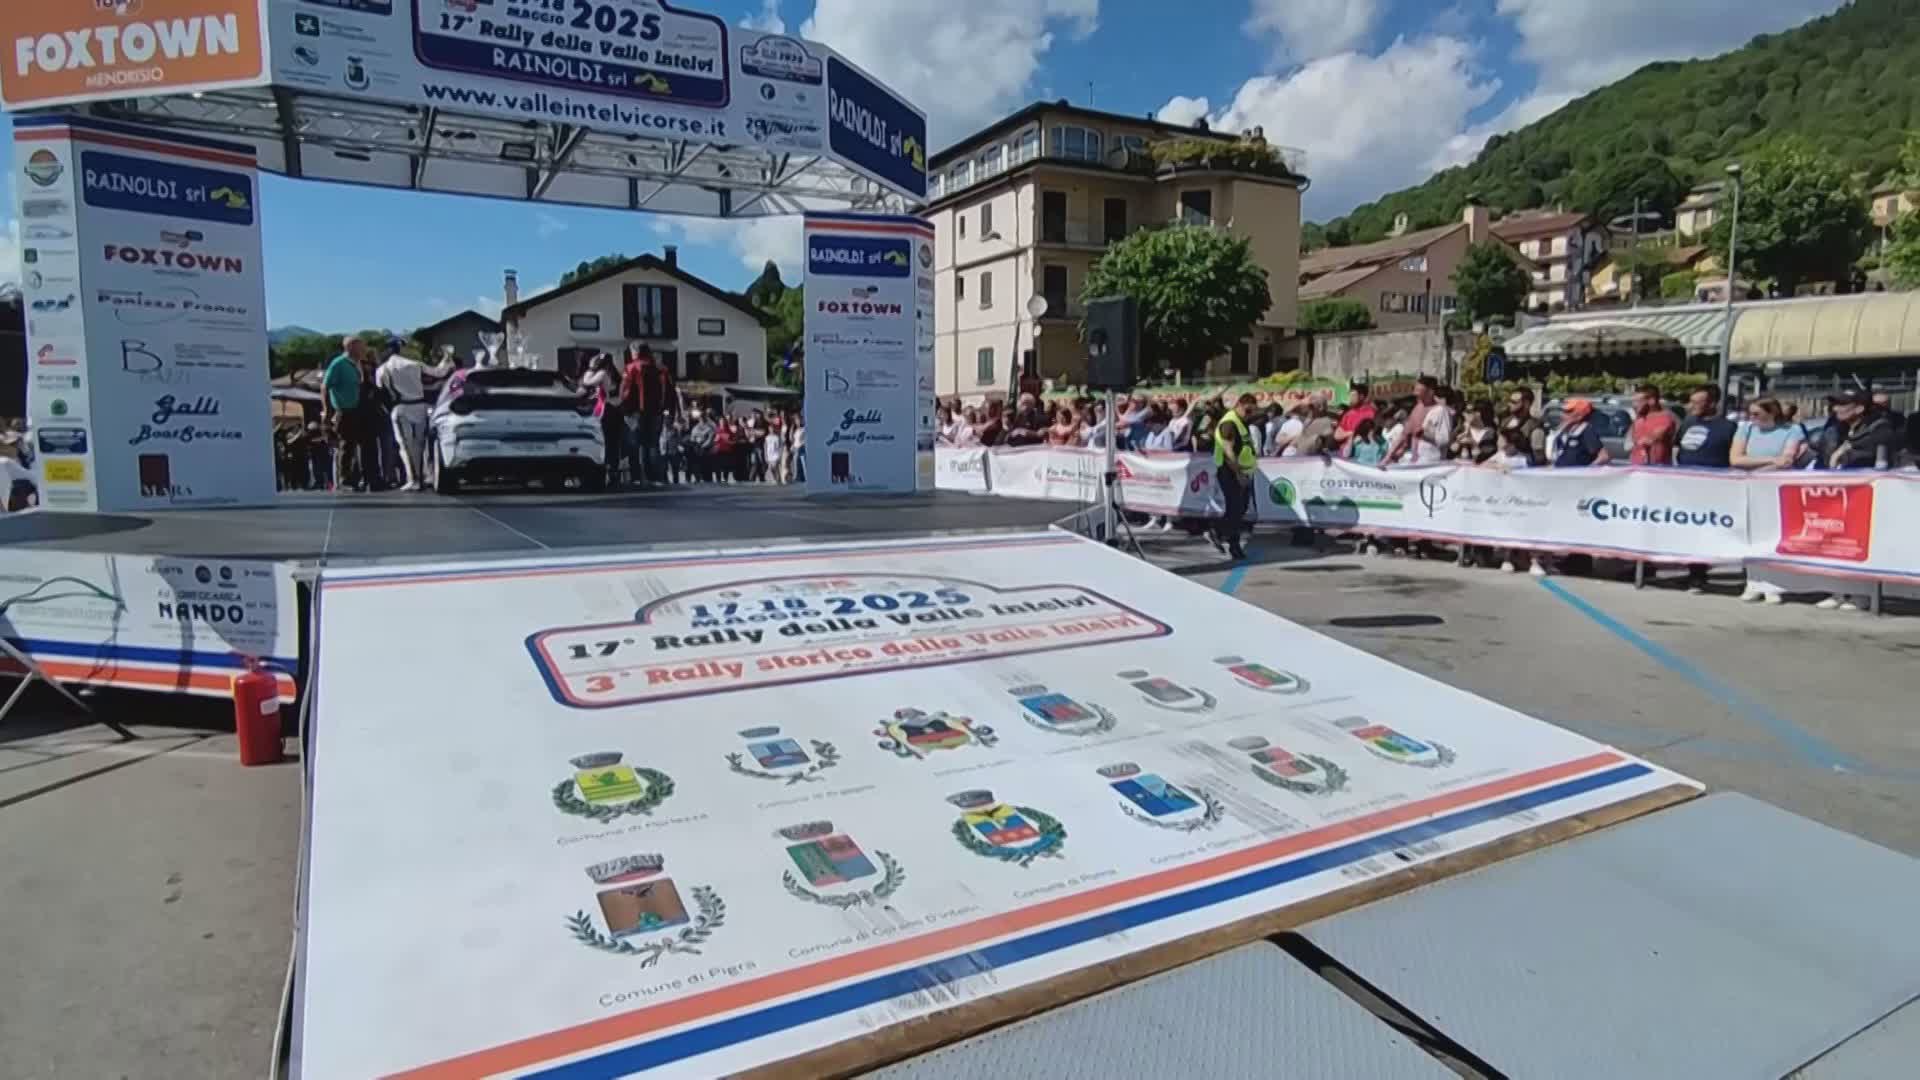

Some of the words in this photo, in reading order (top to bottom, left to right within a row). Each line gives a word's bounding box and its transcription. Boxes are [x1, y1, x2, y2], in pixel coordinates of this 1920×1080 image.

[506, 7, 565, 25] MAGGIO
[570, 1, 661, 41] 2025
[16, 14, 240, 76] FOXTOWN
[480, 19, 535, 47] Rally
[540, 31, 593, 53] della
[600, 40, 650, 64] Valle
[654, 50, 714, 73] Intelvi
[86, 67, 164, 88] MENDRISIO
[492, 48, 604, 83] RAINOLDI
[608, 72, 628, 86] srl
[421, 83, 727, 137] www.valleintelvicorse.it
[831, 87, 887, 150] RAINOLDI
[85, 169, 178, 200] RAINOLDI
[185, 186, 207, 203] srl
[104, 244, 243, 274] FOXTOWN
[811, 247, 865, 264] RAINOLDI
[818, 301, 902, 315] FOXTOWN
[151, 394, 221, 424] Galli
[840, 408, 882, 430] Galli
[1591, 499, 1735, 529] Clericiauto
[158, 602, 244, 624] NANDO
[824, 587, 972, 617] 2025
[652, 627, 765, 651] Rally
[779, 610, 879, 638] della
[886, 606, 985, 628] Valle
[990, 592, 1098, 618] Intelvi
[690, 608, 822, 629] MAGGIO
[643, 660, 745, 686] Rally
[756, 647, 872, 673] storico
[880, 635, 961, 658] della
[967, 624, 1047, 645] Valle
[1049, 614, 1142, 635] Intelvi
[599, 977, 685, 1009] Comune
[687, 968, 705, 984] di
[709, 960, 759, 984] Pigra
